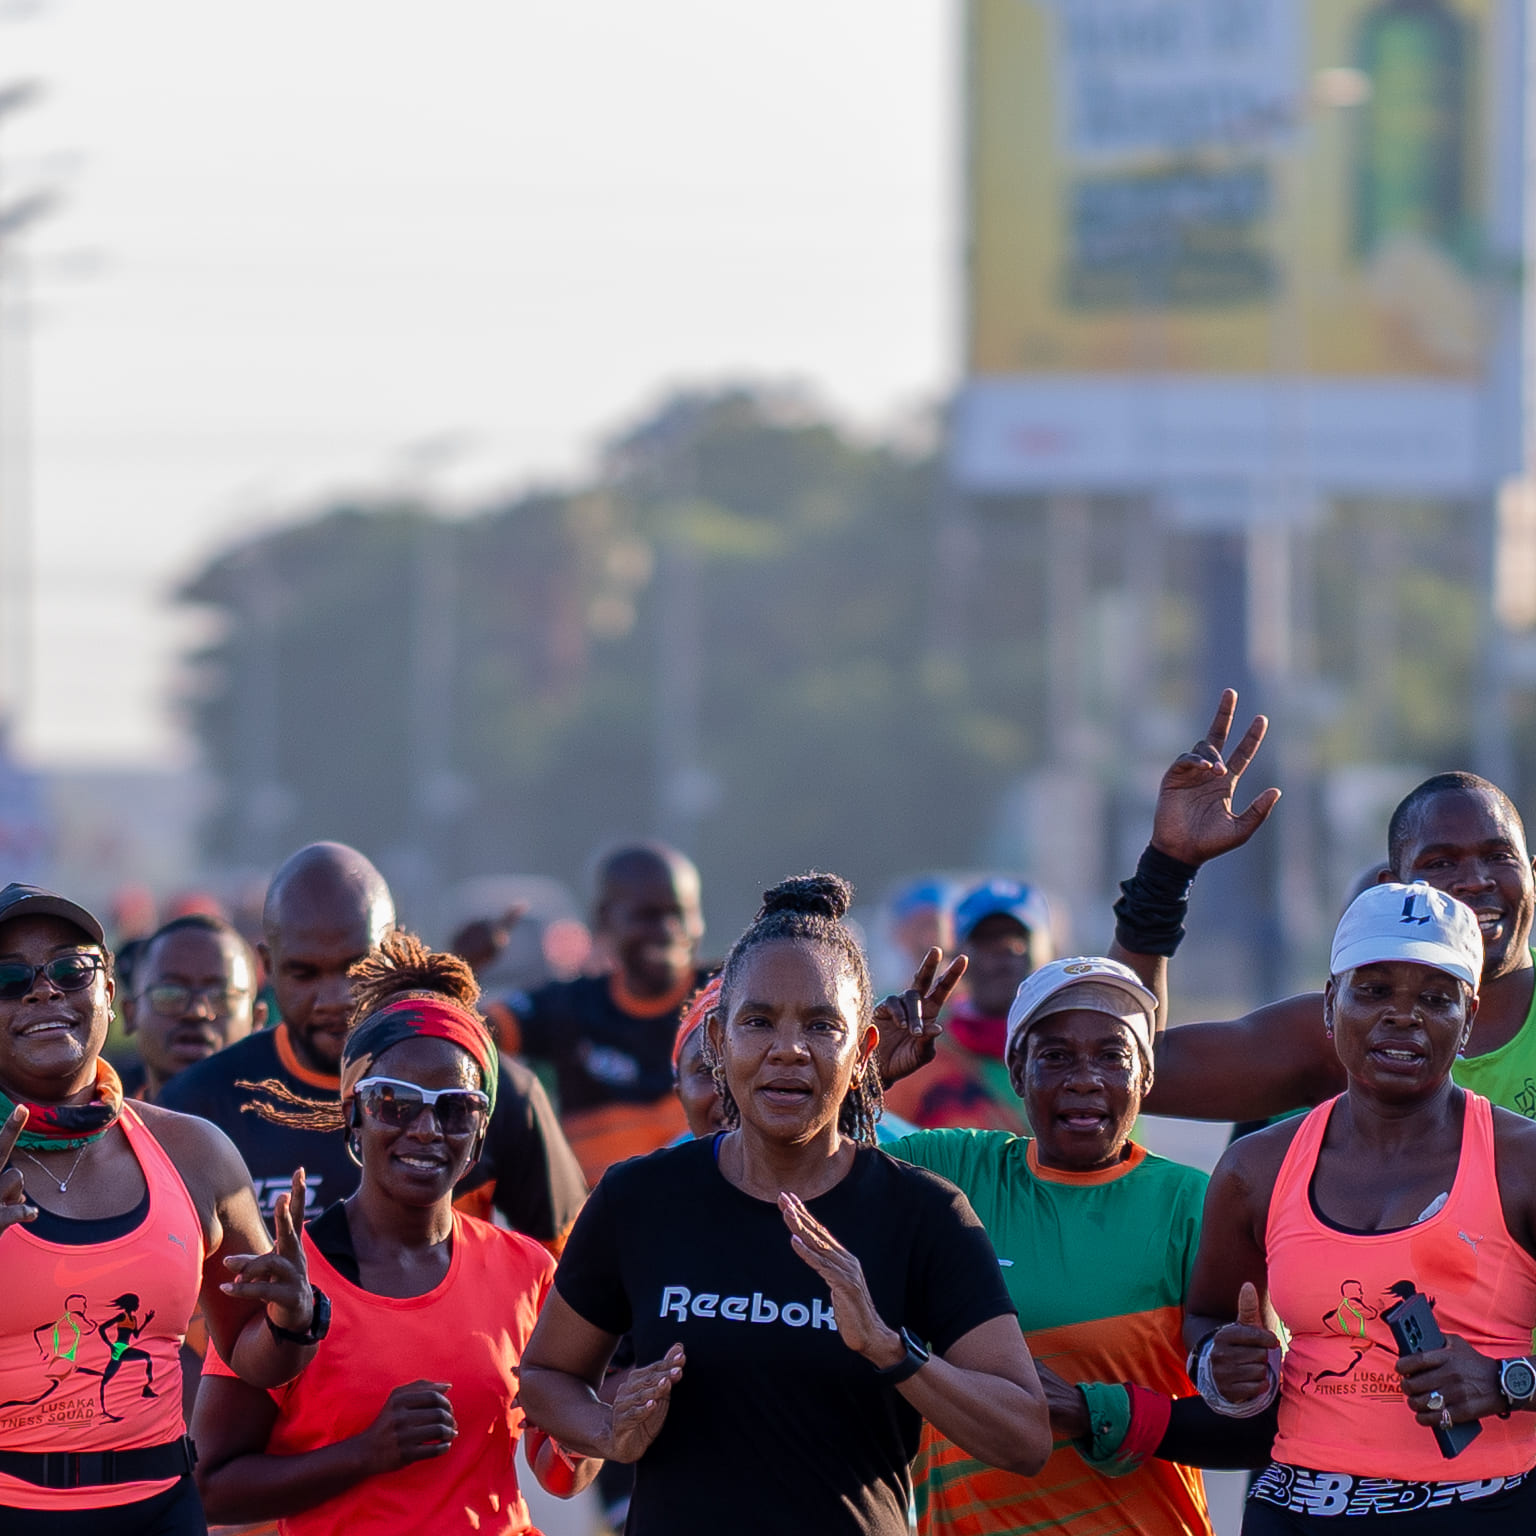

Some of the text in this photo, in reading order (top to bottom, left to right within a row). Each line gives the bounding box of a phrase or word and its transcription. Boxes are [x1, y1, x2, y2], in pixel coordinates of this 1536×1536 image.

[660, 1286, 838, 1331] Reebok
[1354, 1371, 1402, 1384] LUSAKA
[1314, 1384, 1357, 1395] FITNESS
[41, 1398, 95, 1414] LUSAKA
[47, 1408, 93, 1422] SQUAD
